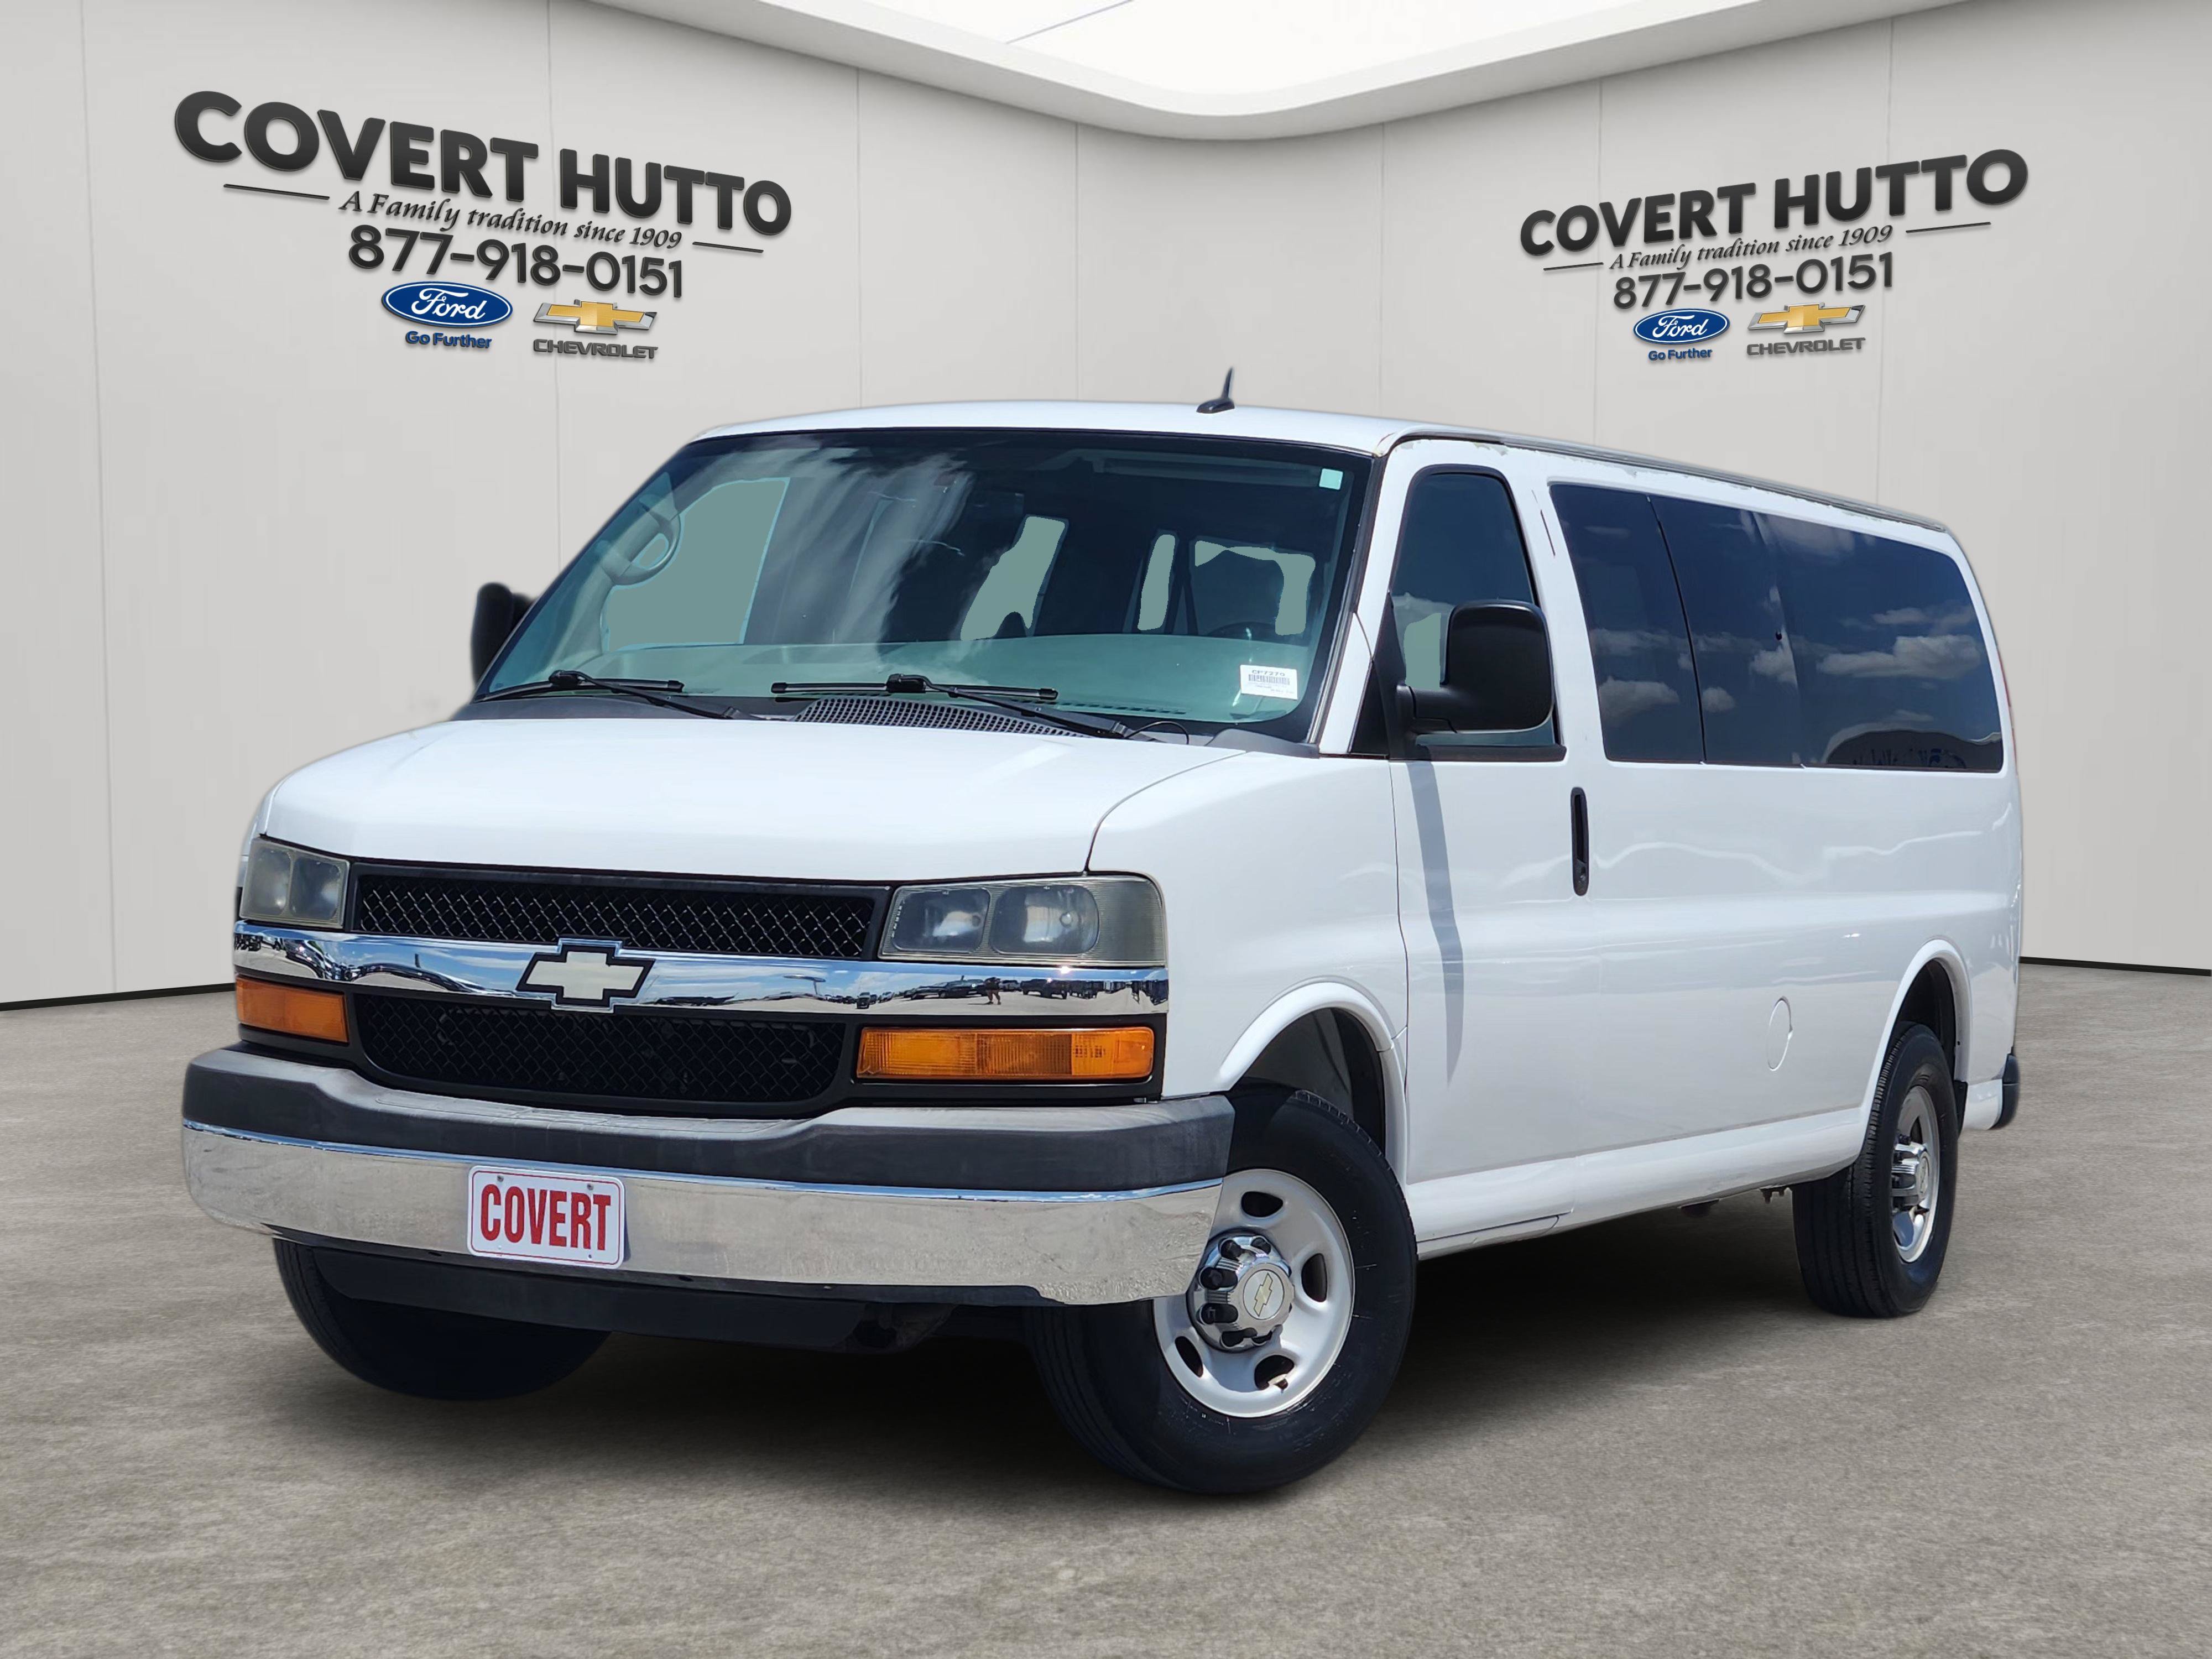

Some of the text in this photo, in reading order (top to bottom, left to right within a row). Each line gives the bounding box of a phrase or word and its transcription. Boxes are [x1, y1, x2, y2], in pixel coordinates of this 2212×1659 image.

[174, 91, 791, 236] COVERT HUTTO
[338, 191, 682, 249] A Family tradition since 1909
[1520, 149, 2028, 257] COVERT HUTTO
[348, 225, 682, 299] 877-918-0151
[1609, 225, 1893, 271] A Family tradition since 1909
[411, 288, 487, 320] Ford
[1613, 252, 1893, 310] 877-918-0151
[405, 331, 492, 349] Go Further
[533, 338, 659, 359] CHEVROLET
[1652, 315, 1708, 338] Ford
[1746, 337, 1866, 356] CHEVROLET
[1648, 348, 1713, 361] Go Further
[480, 1184, 611, 1251] COVERT
